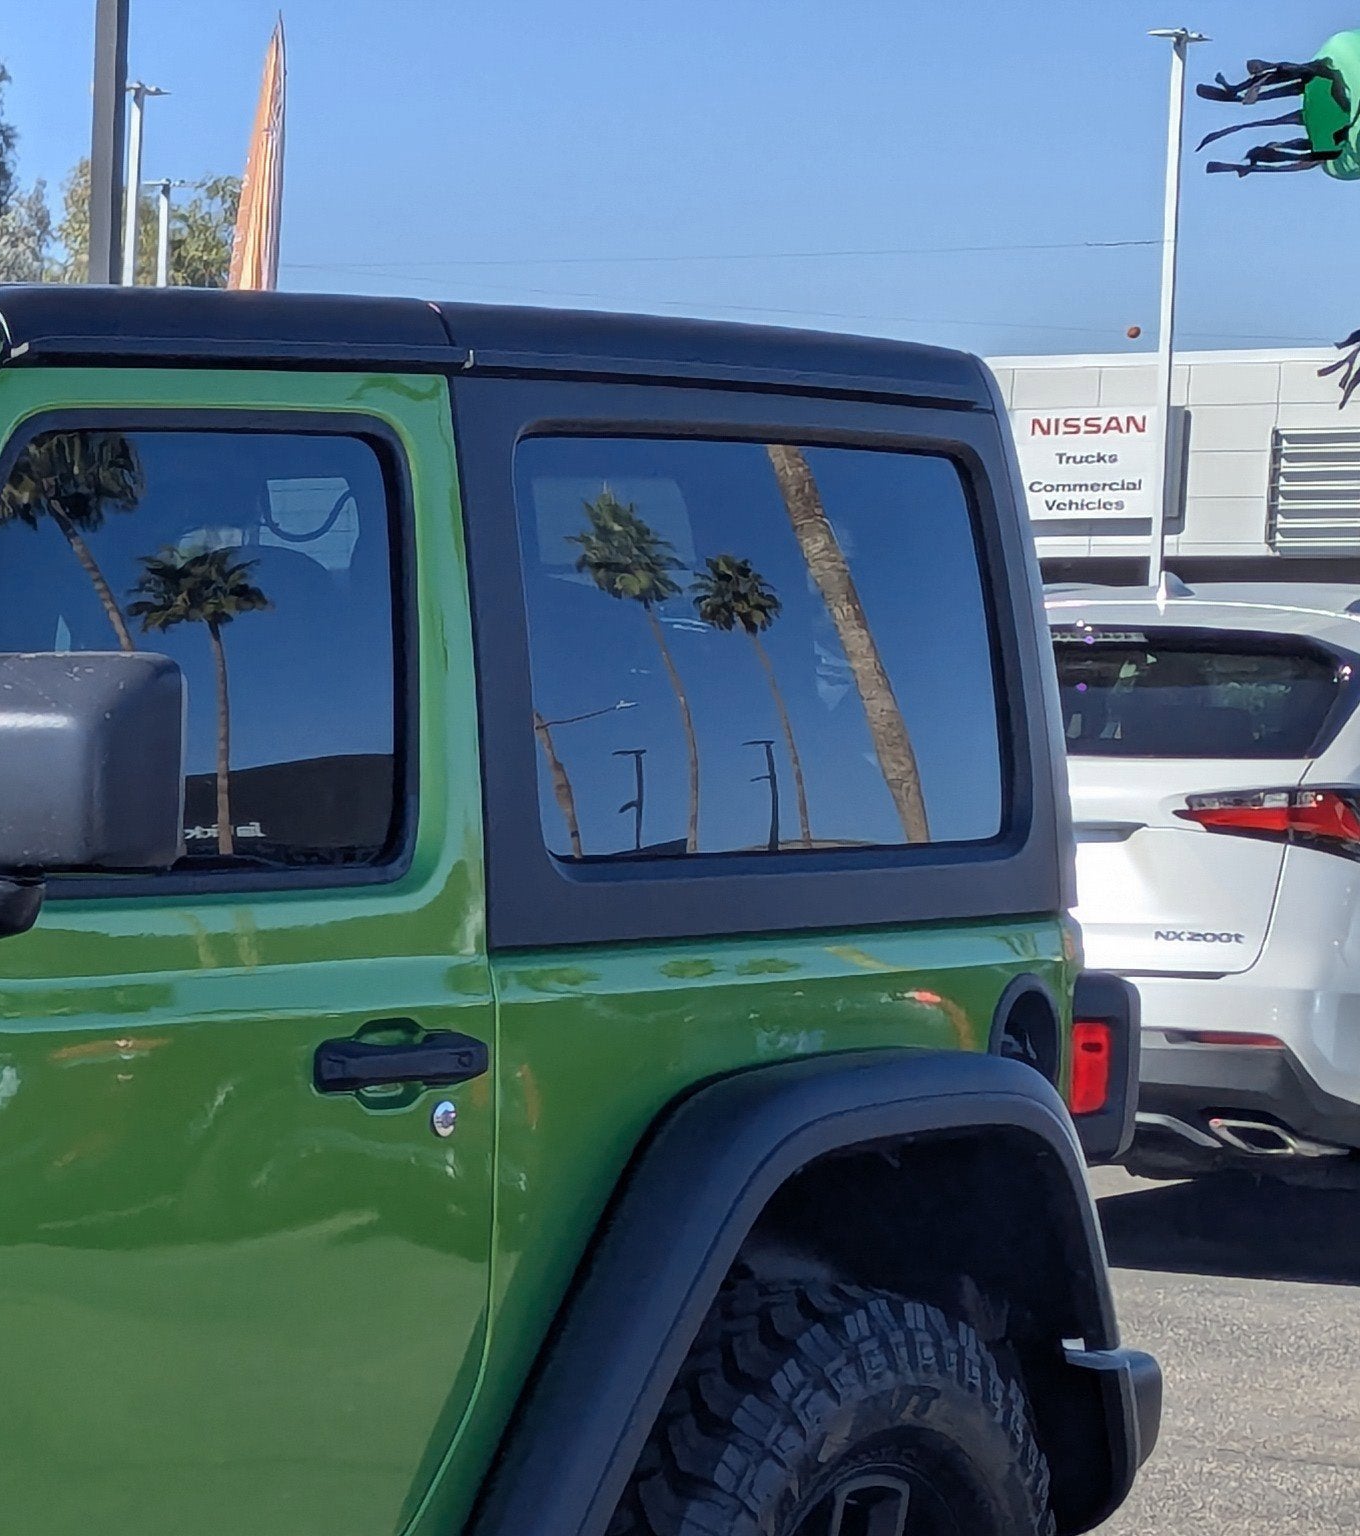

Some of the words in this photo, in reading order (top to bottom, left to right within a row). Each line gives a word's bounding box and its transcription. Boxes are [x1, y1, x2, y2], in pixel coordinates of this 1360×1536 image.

[1030, 415, 1147, 437] NISSAN
[1055, 452, 1119, 465] Trucks
[1028, 479, 1142, 493] Commercial
[1044, 499, 1125, 511] Vehicles
